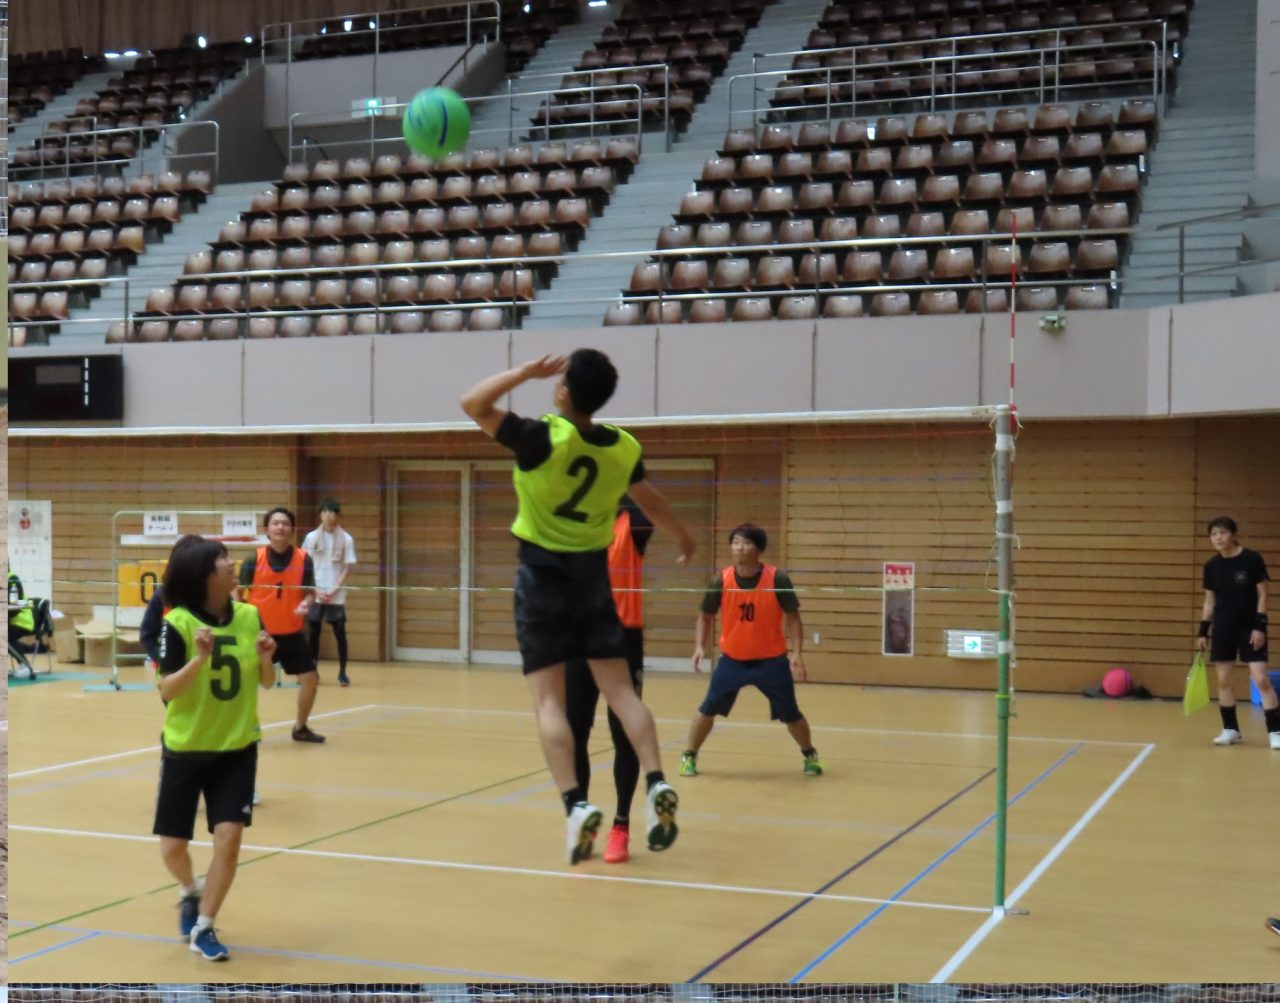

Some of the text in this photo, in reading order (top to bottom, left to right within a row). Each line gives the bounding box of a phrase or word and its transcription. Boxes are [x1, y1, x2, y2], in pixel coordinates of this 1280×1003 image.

[553, 454, 598, 523] 2
[739, 602, 755, 622] 10
[210, 635, 241, 701] 5
